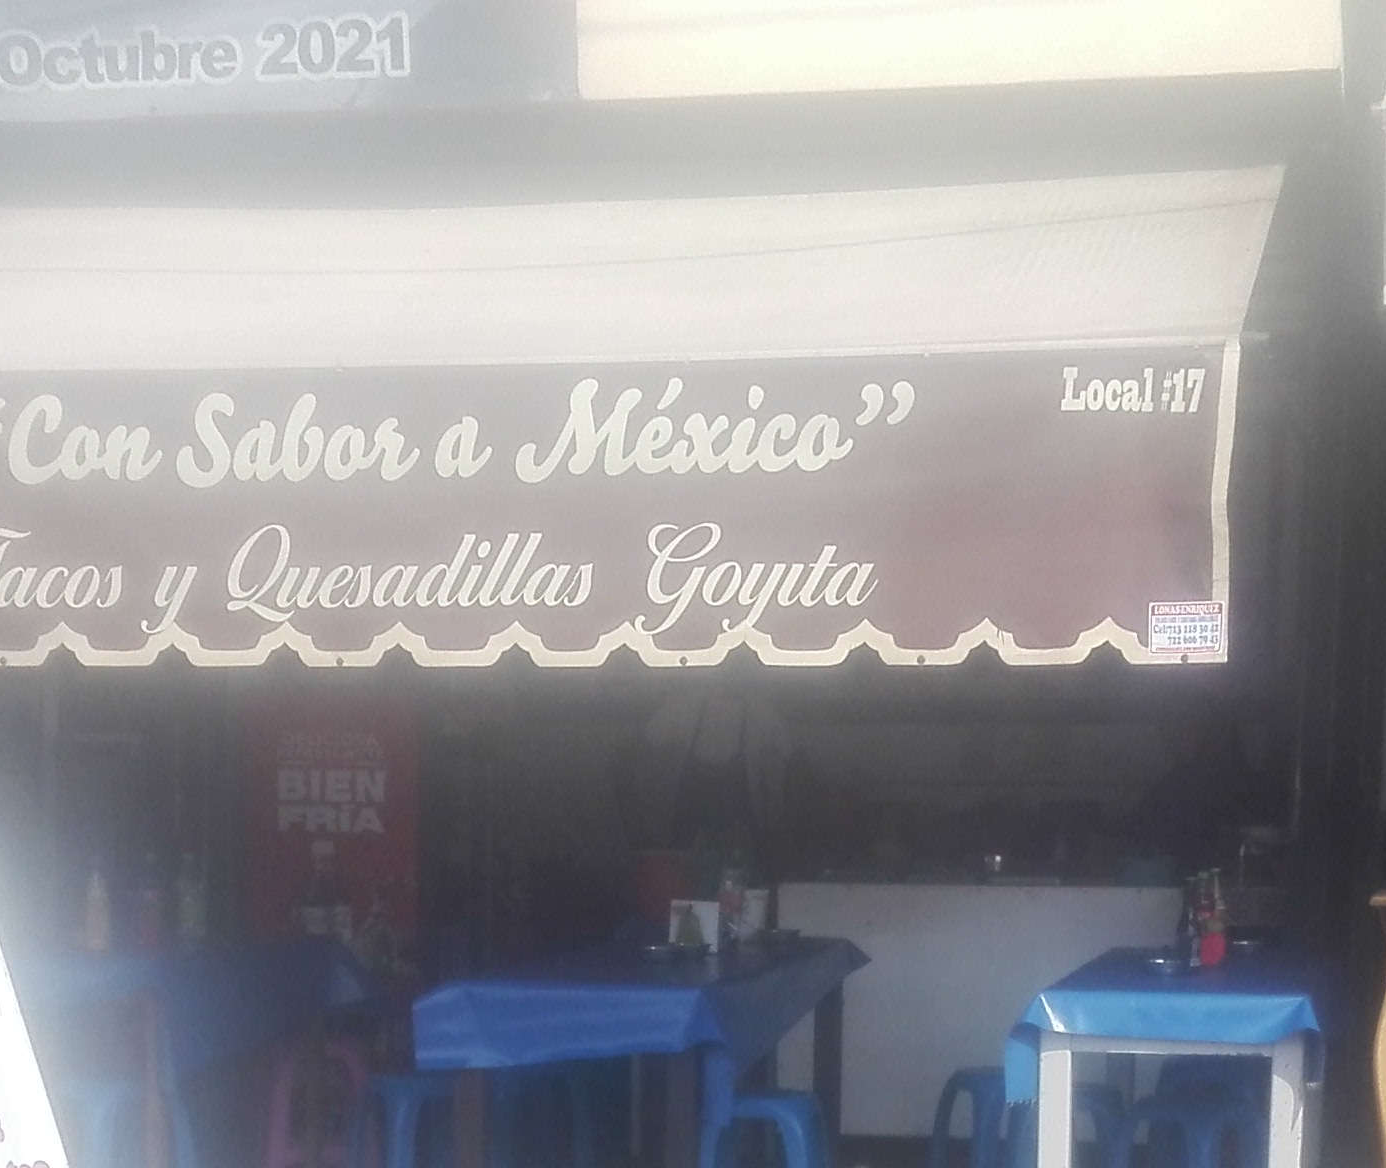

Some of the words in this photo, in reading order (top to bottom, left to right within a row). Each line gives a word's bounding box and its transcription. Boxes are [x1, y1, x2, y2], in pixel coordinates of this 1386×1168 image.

[258, 12, 411, 80] 2021
[1060, 366, 1154, 412] Local
[175, 391, 420, 489] Sabor
[434, 415, 493, 478] a
[139, 564, 198, 634] y
[225, 523, 595, 623] Quesadillas
[277, 769, 386, 802] BIEN
